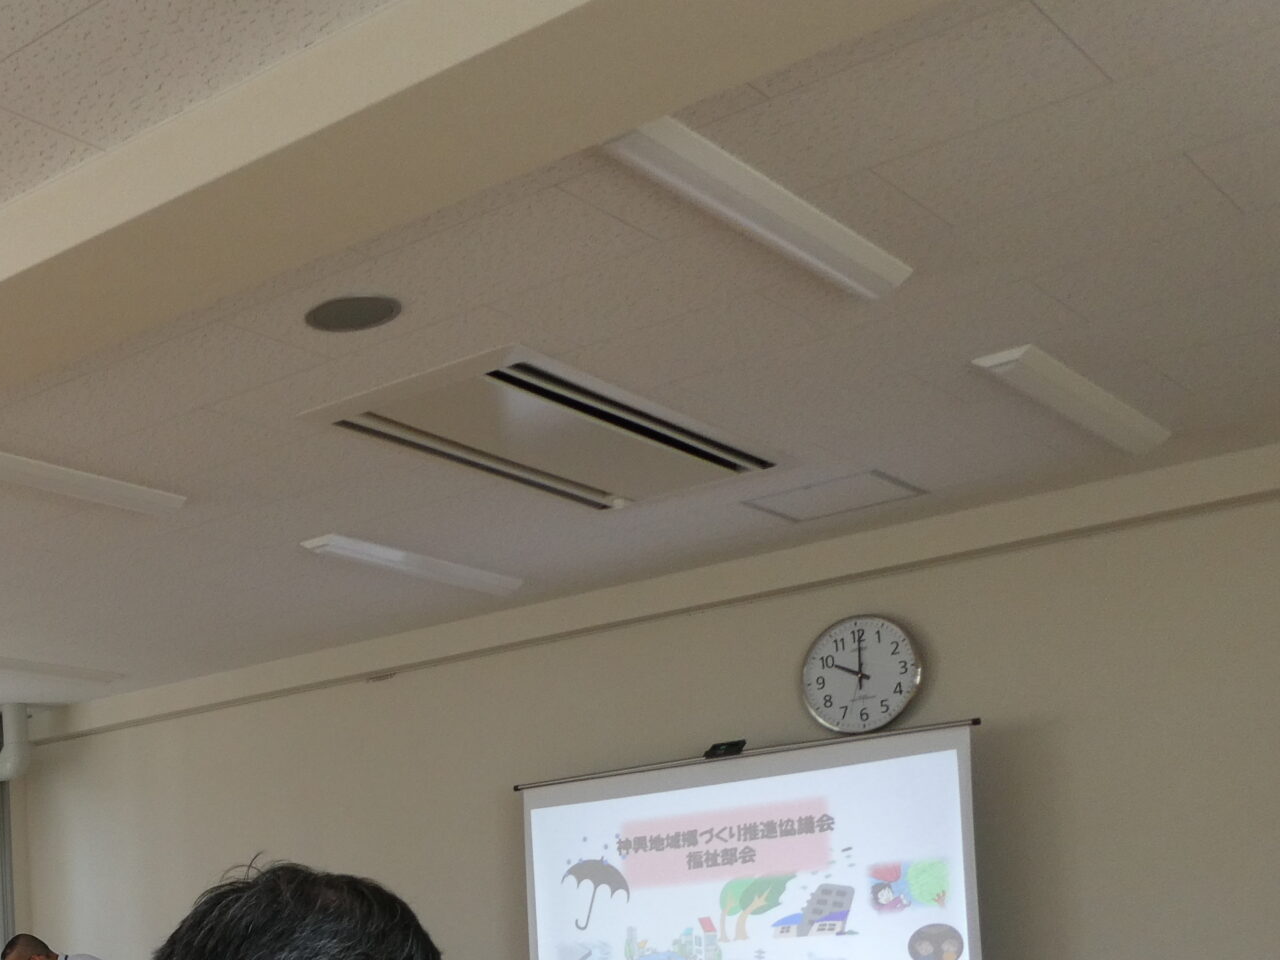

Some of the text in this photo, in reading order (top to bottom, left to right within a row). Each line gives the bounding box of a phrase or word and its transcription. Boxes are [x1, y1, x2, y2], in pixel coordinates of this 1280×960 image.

[850, 628, 865, 643] 12
[875, 630, 881, 644] 1
[833, 638, 846, 653] 11
[890, 641, 900, 656] 2
[819, 654, 835, 670] 10
[898, 660, 908, 675] 3
[816, 676, 826, 690] 9
[893, 682, 903, 695] 4
[823, 694, 833, 708] 8
[880, 699, 890, 713] 5
[839, 705, 848, 720] 7
[859, 707, 869, 722] 6
[686, 846, 757, 870] 福祉部会
